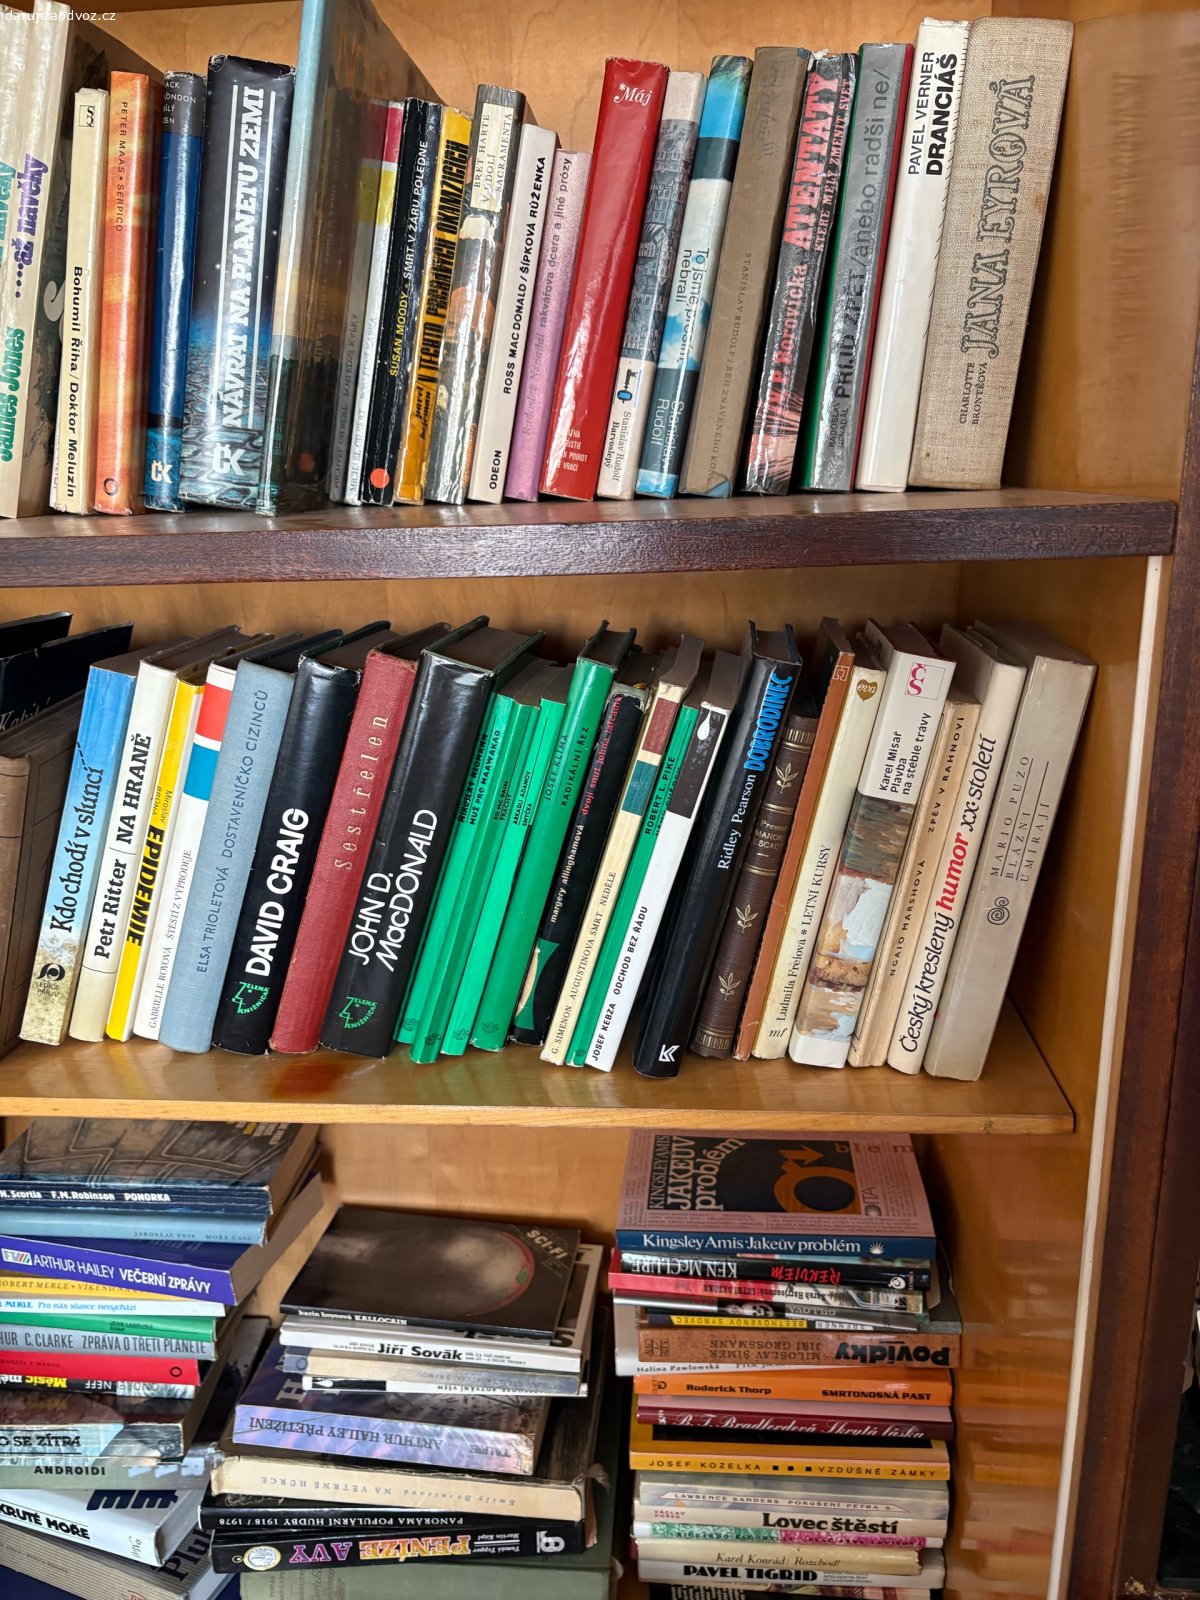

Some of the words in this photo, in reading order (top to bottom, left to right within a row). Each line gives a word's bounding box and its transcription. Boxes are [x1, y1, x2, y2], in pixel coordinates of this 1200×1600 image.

[915, 51, 935, 120] VERNER
[240, 86, 264, 160] ZEMI
[926, 53, 957, 176] DRANCIÁŠ
[117, 140, 126, 173] MAAS
[474, 160, 483, 190] BRET
[479, 112, 491, 155] HARTE
[494, 112, 512, 193] SACRAMENTA
[785, 72, 839, 250] ATENTATY
[863, 115, 882, 176] radši
[908, 124, 926, 175] PAVEL
[978, 74, 1035, 244] EYROVÁ
[413, 141, 428, 196] POLEDNE
[115, 184, 124, 232] SERPICO
[233, 164, 260, 281] PLANETU
[409, 200, 424, 232] ŽÁRU
[548, 238, 559, 270] dcera
[560, 157, 573, 188] prózy
[403, 245, 417, 280] SMRT
[503, 369, 513, 395] ROSS
[519, 221, 535, 274] ŠÍPKOVÁ
[529, 157, 545, 219] RŮŽENKA
[675, 249, 692, 303] nebrali
[736, 251, 752, 311] STANISLAV
[71, 266, 82, 334] Bohumil
[229, 284, 251, 328] NA
[396, 292, 409, 338] MOODY
[960, 247, 1010, 360] JANA
[70, 337, 83, 372] Říha
[389, 339, 404, 377] SUSAN
[67, 383, 79, 434] Doktor
[959, 361, 976, 425] CHARLOTTE
[619, 411, 631, 451] Stanislav
[651, 398, 670, 447] Rudolf
[601, 421, 620, 470] Barvoslepý
[66, 439, 80, 497] Meluzin
[489, 449, 502, 490] ODEON
[612, 452, 625, 482] Rudolf
[743, 673, 793, 772] DOBRODINEC
[886, 730, 903, 756] Misař
[915, 712, 932, 742] trávy
[122, 733, 151, 810] HRANĚ
[223, 754, 252, 860] DOSTAVENÍČKO
[245, 689, 268, 753] CIZINCŮ
[544, 769, 559, 801] JOSEF
[554, 734, 569, 768] KLÍMA
[561, 751, 582, 806] RADIKÁLNÍ
[579, 727, 589, 750] ŘEZ
[879, 758, 895, 792] Karel
[890, 757, 907, 794] Plavba
[905, 742, 921, 781] stéble
[969, 732, 997, 801] století
[161, 790, 172, 824] Miroslav
[334, 716, 389, 871] Sestřelen
[474, 787, 483, 804] PRO
[644, 800, 661, 836] ROBERT
[662, 756, 676, 782] PIKE
[731, 774, 757, 825] Pearson
[902, 782, 911, 795] na
[78, 824, 91, 838] v
[115, 816, 136, 845] NA
[755, 829, 784, 840] MANON
[990, 817, 1013, 878] MARIO
[1010, 756, 1031, 804] PUZO
[549, 887, 566, 924] margery
[561, 823, 585, 886] allinghamová
[588, 767, 601, 789] smrt
[717, 827, 742, 870] Ridley
[1005, 811, 1032, 880] BLÁZNI
[1020, 801, 1051, 883] UMÍRAJÍ
[59, 839, 89, 893] chodí
[126, 824, 165, 947] EPIDEMIE
[174, 850, 192, 902] VÝPRODEJE
[366, 872, 394, 897] D.
[812, 845, 831, 894] KURSY
[934, 831, 970, 912] humor
[102, 858, 127, 917] Ritter
[203, 865, 231, 944] TRIOLETOVÁ
[244, 900, 286, 977] DAVID
[265, 807, 310, 895] CRAIG
[375, 808, 438, 973] MacDONALD
[49, 894, 77, 933] Kdo
[347, 896, 386, 966] JOHN
[632, 906, 649, 936] ŘÁDU
[801, 895, 816, 927] LETNÍ
[889, 936, 905, 977] NGAIO
[902, 860, 925, 931] MARSHOVÁ
[94, 917, 115, 959] Petr
[197, 944, 212, 974] ELSA
[554, 1005, 573, 1044] SIMENON
[570, 938, 596, 1000] AUGUSTINOVA
[588, 911, 604, 938] SMRT
[600, 871, 617, 907] NEDĚLE
[627, 935, 639, 954] BEZ
[786, 938, 807, 979] Freiová
[914, 913, 955, 994] kreslený
[613, 956, 632, 996] ODCHOD
[149, 982, 166, 1029] GABRIELLE
[777, 979, 796, 1022] Ludmila
[591, 1034, 606, 1062] JOSEF
[600, 1002, 617, 1034] KEBZA
[899, 994, 934, 1053] Český
[695, 1138, 747, 1211] problém
[123, 1193, 171, 1202] PONORKA
[642, 1233, 704, 1251] Kingsley
[797, 1239, 860, 1254] problém
[33, 1253, 76, 1272] ARTHUR
[78, 1260, 115, 1279] HAILEY
[119, 1267, 167, 1287] VEČERNÍ
[167, 1276, 211, 1295] ZPRÁVY
[37, 1281, 71, 1290] MERLE
[706, 1261, 738, 1279] KEN
[354, 1315, 408, 1326] KALLOCAIN
[82, 1334, 122, 1351] ZPRÁVA
[377, 1342, 407, 1356] Jiří
[411, 1345, 463, 1361] Sovák
[710, 1340, 792, 1351] GROSSMANN
[759, 1350, 821, 1361] MILOSLAV
[834, 1342, 950, 1367] Povídky
[84, 1380, 112, 1390] NEFF
[686, 1384, 736, 1393] Roderick
[738, 1386, 772, 1395] Thorp
[821, 1389, 900, 1401] SMRTONOSNÁ
[902, 1392, 933, 1401] PAST
[12, 1436, 36, 1447] SE
[36, 1433, 80, 1447] ZÍTRA
[248, 1416, 324, 1438] PŘETÍŽENÍ
[328, 1426, 381, 1442] HAILEY
[384, 1433, 443, 1450] ARTHUR
[34, 1465, 106, 1476] ANDROIDI
[648, 1461, 692, 1469] JOSEF
[699, 1462, 762, 1471] KOZELKA
[818, 1464, 882, 1476] VZDUŠNÉ
[890, 1467, 936, 1478] ZÁMKY
[0, 1502, 43, 1527] KRUTÉ
[46, 1516, 91, 1541] MOŘE
[218, 1518, 243, 1526] 1978
[254, 1518, 279, 1526] 1918
[283, 1517, 324, 1527] HUDBY
[329, 1517, 394, 1527] POPULÁRNÍ
[398, 1517, 464, 1527] PANORÁMA
[762, 1512, 828, 1531] Lovec
[831, 1513, 899, 1535] štěstí
[288, 1541, 353, 1564] AVY
[358, 1535, 472, 1563] PENÍZE
[716, 1552, 744, 1563] Karel
[683, 1565, 742, 1579] PAVEL
[743, 1566, 818, 1582] TIGRID
